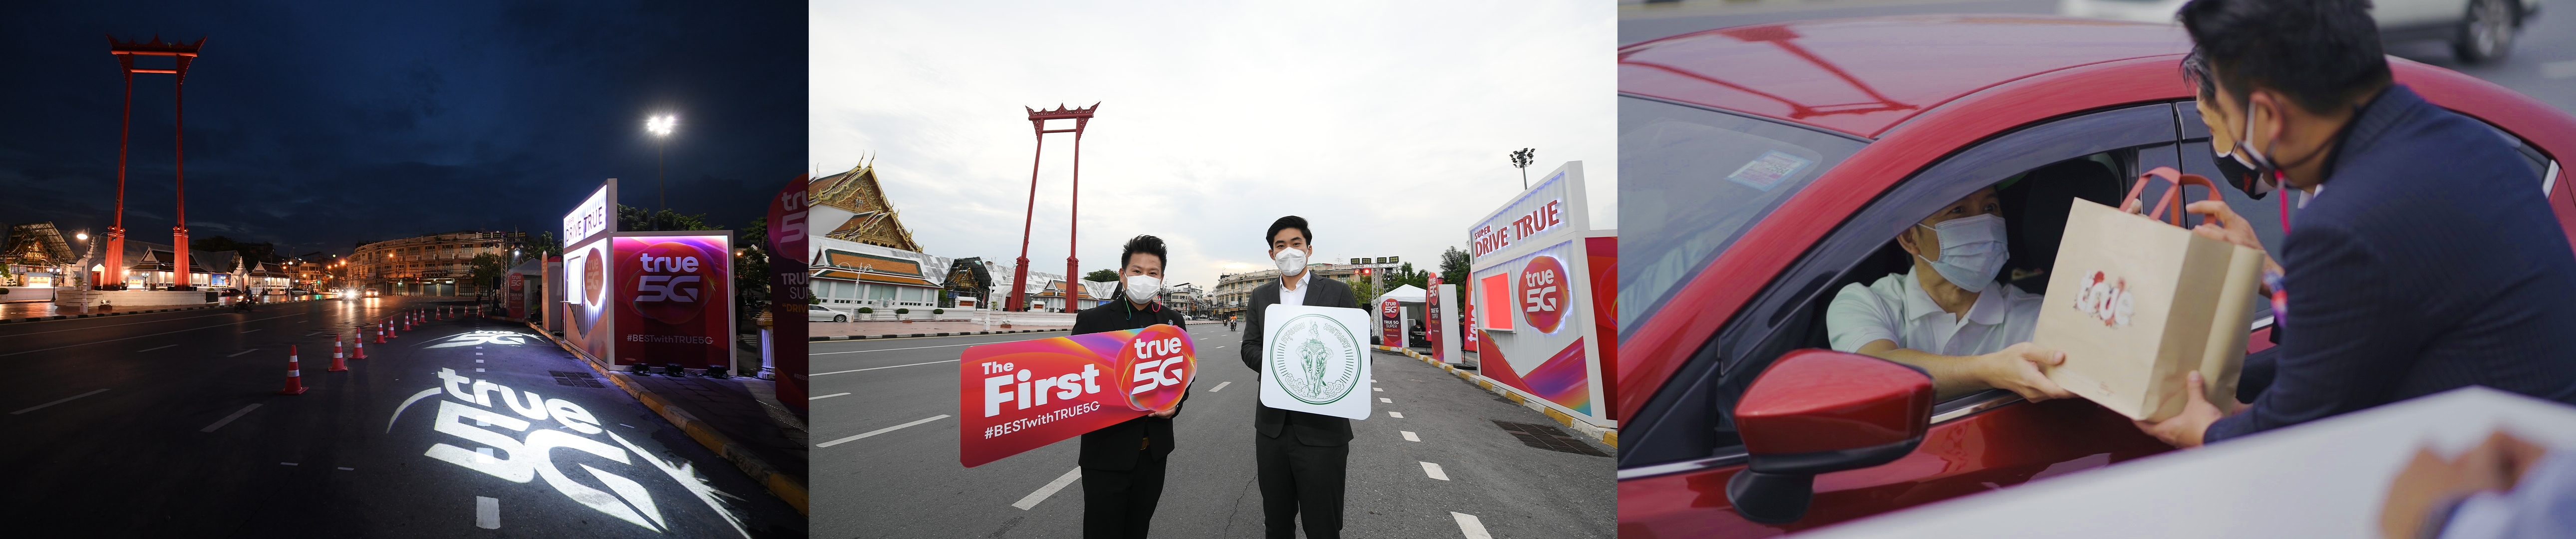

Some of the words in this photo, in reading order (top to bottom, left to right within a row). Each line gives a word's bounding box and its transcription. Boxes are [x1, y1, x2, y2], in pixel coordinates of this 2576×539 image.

[566, 221, 581, 242] DRIVE
[584, 207, 602, 233] TRUE
[1475, 227, 1508, 258] DRIVE
[1513, 200, 1559, 240] TRUE
[1475, 225, 1491, 240] SUPER
[588, 258, 599, 270] true
[640, 253, 699, 272] true
[587, 270, 599, 290] 5G
[635, 275, 700, 302] 5G
[1526, 269, 1554, 287] true
[1429, 284, 1437, 297] 5G
[1527, 285, 1556, 312] 5G
[2077, 270, 2134, 326] true
[423, 334, 526, 349] 5G
[627, 334, 713, 344] #BESTwithTRUE5G
[1134, 337, 1182, 359] true
[982, 361, 1014, 375] The
[1131, 356, 1184, 395] 5G
[438, 367, 602, 434] true
[984, 363, 1100, 418] First
[984, 401, 1100, 440] #BESTwithTRUE5G
[424, 400, 668, 533] 5G
